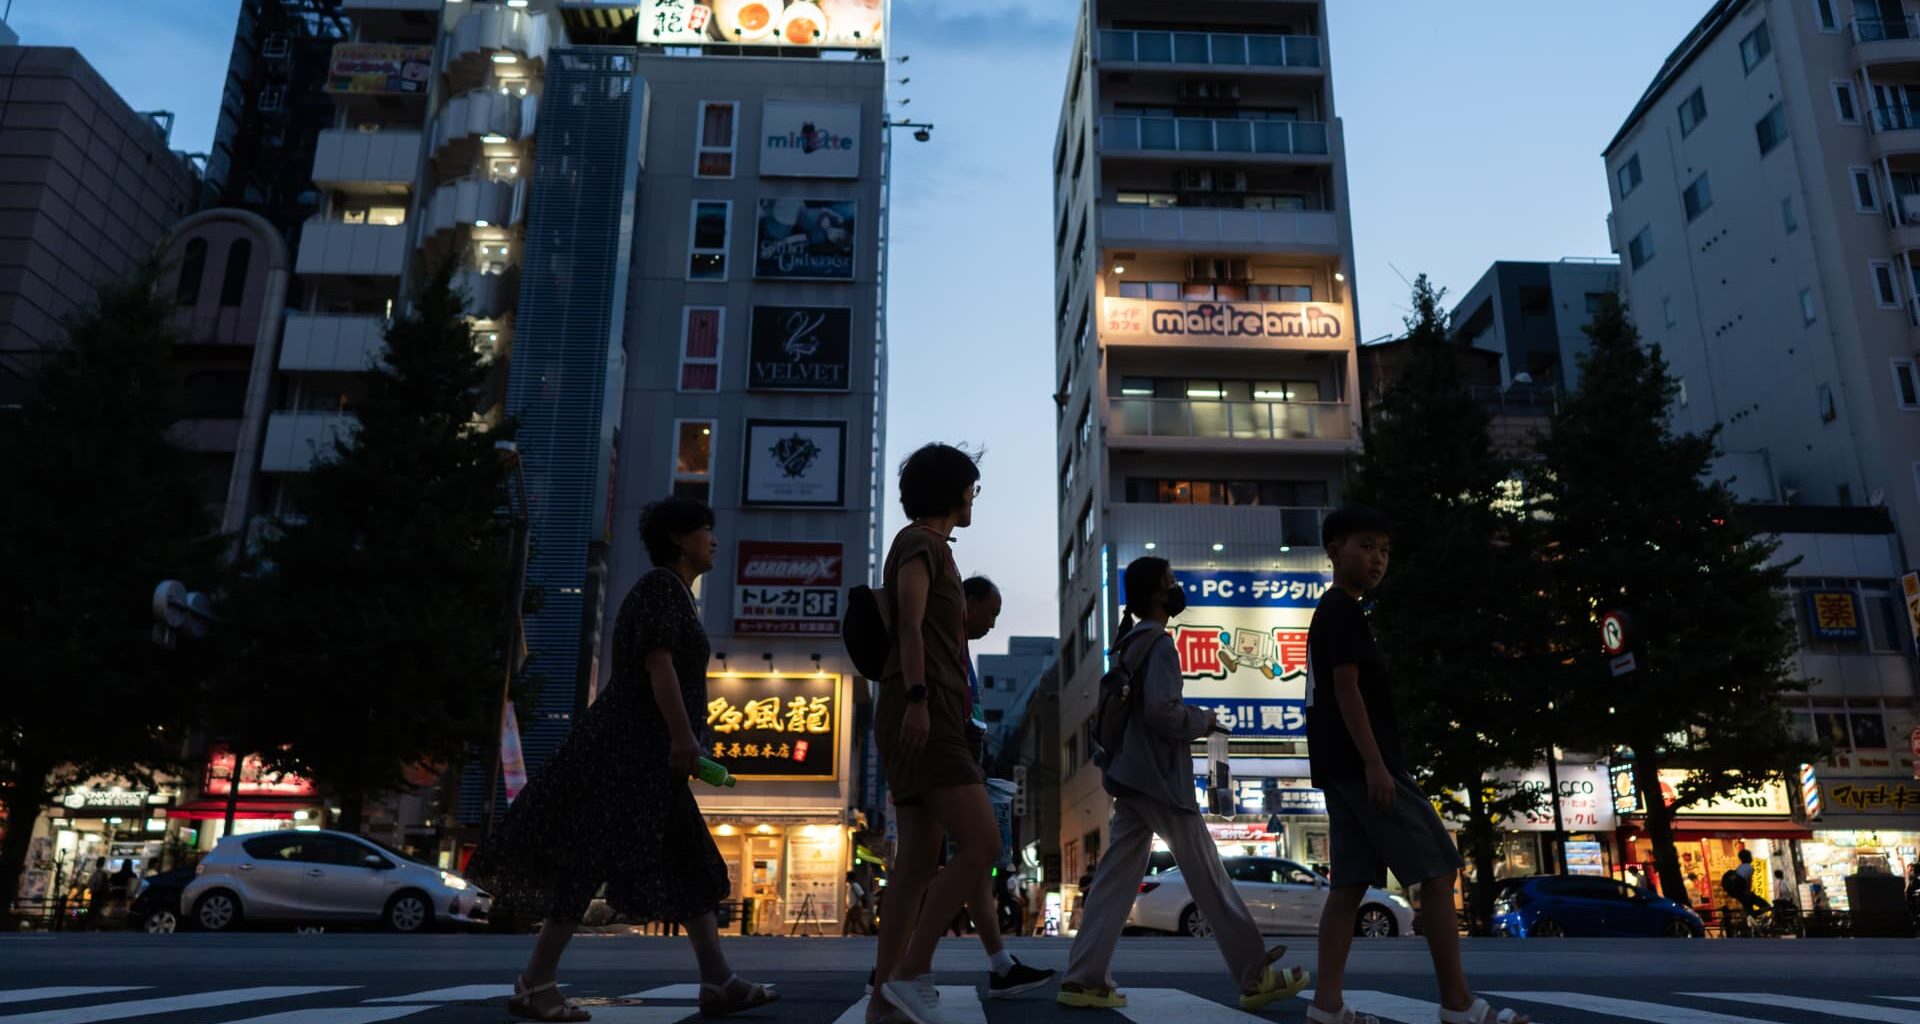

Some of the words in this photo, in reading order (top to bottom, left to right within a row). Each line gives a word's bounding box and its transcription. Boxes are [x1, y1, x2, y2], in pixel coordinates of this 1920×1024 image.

[767, 128, 853, 151] minette
[1109, 320, 1141, 332] カフェ
[1152, 303, 1342, 338] maidreamin
[754, 361, 845, 381] VELVET
[742, 589, 801, 604] トレカ
[806, 592, 836, 615] 3F
[1817, 594, 1853, 626] 薬
[1260, 705, 1306, 730] 買う
[1511, 780, 1594, 795] TOBCCO
